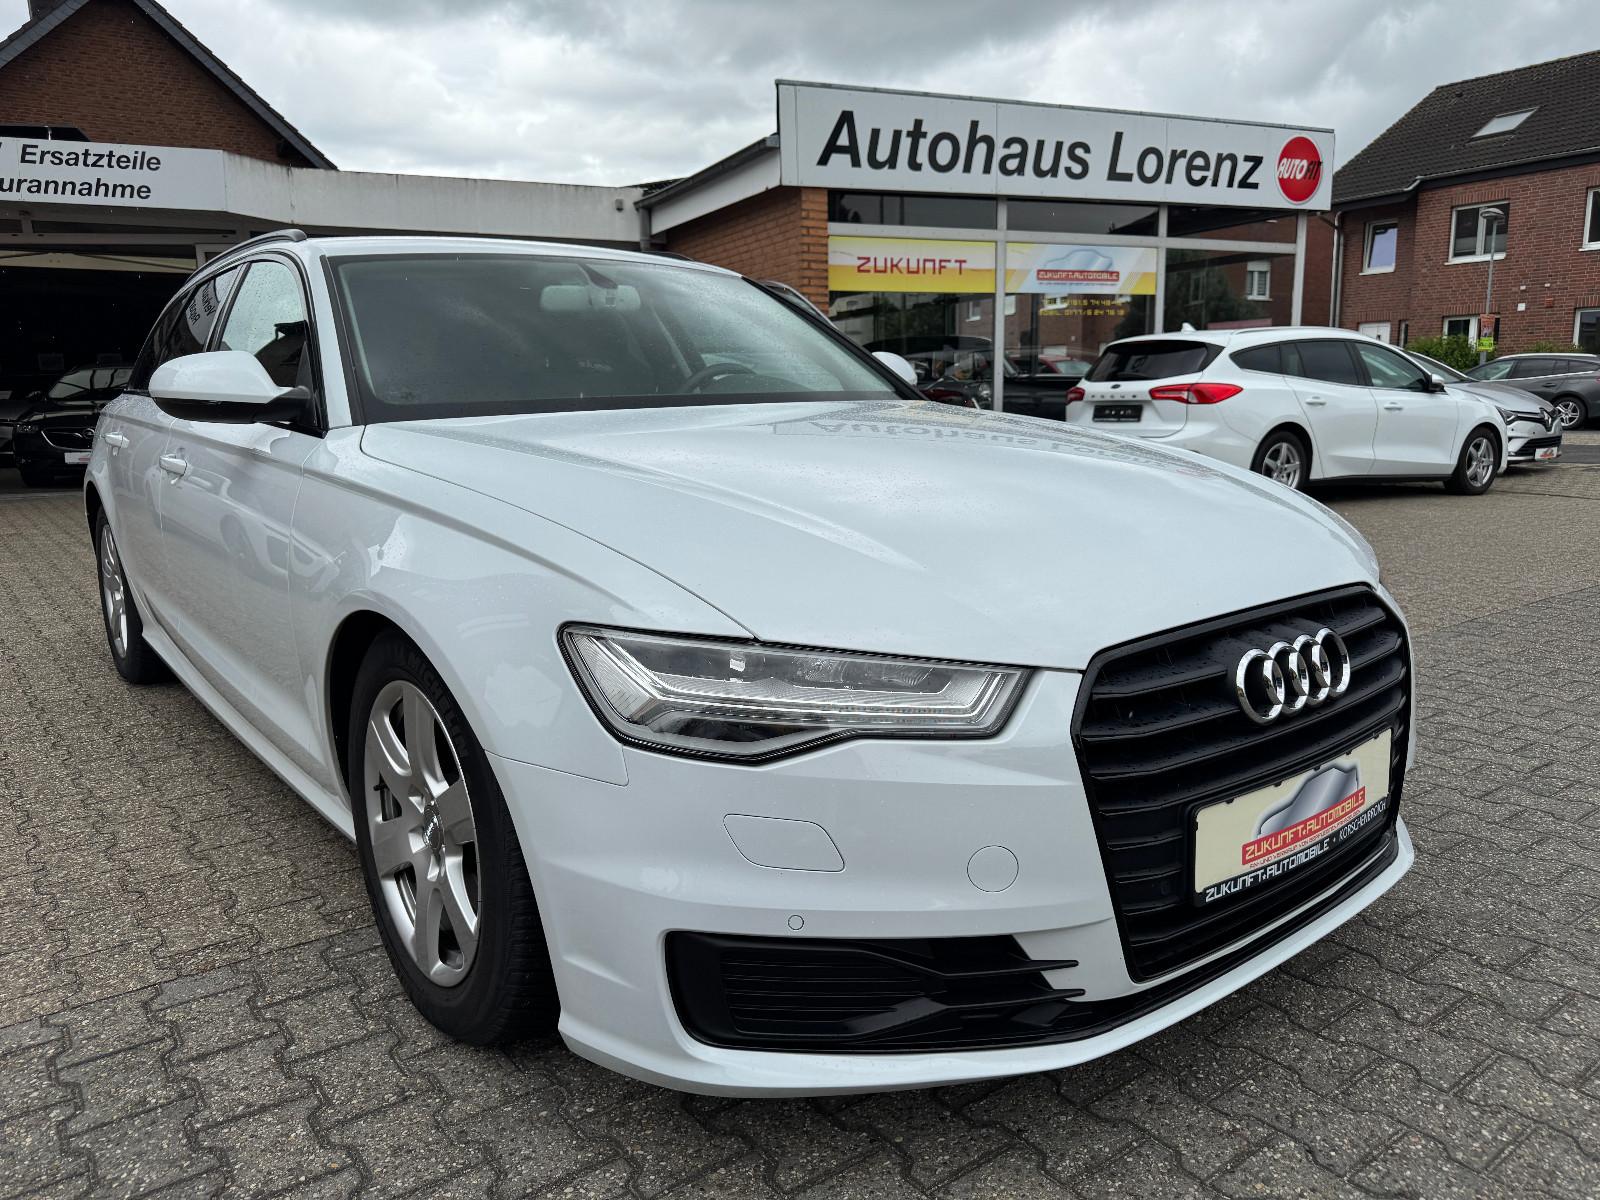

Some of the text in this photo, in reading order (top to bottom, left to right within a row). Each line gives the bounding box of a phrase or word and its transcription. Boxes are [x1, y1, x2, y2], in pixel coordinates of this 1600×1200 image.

[20, 143, 162, 171] Ersatzteile
[816, 109, 1264, 190] Autohaus Lorenz
[0, 177, 151, 199] urannahme
[856, 256, 968, 276] ZUKUNFT
